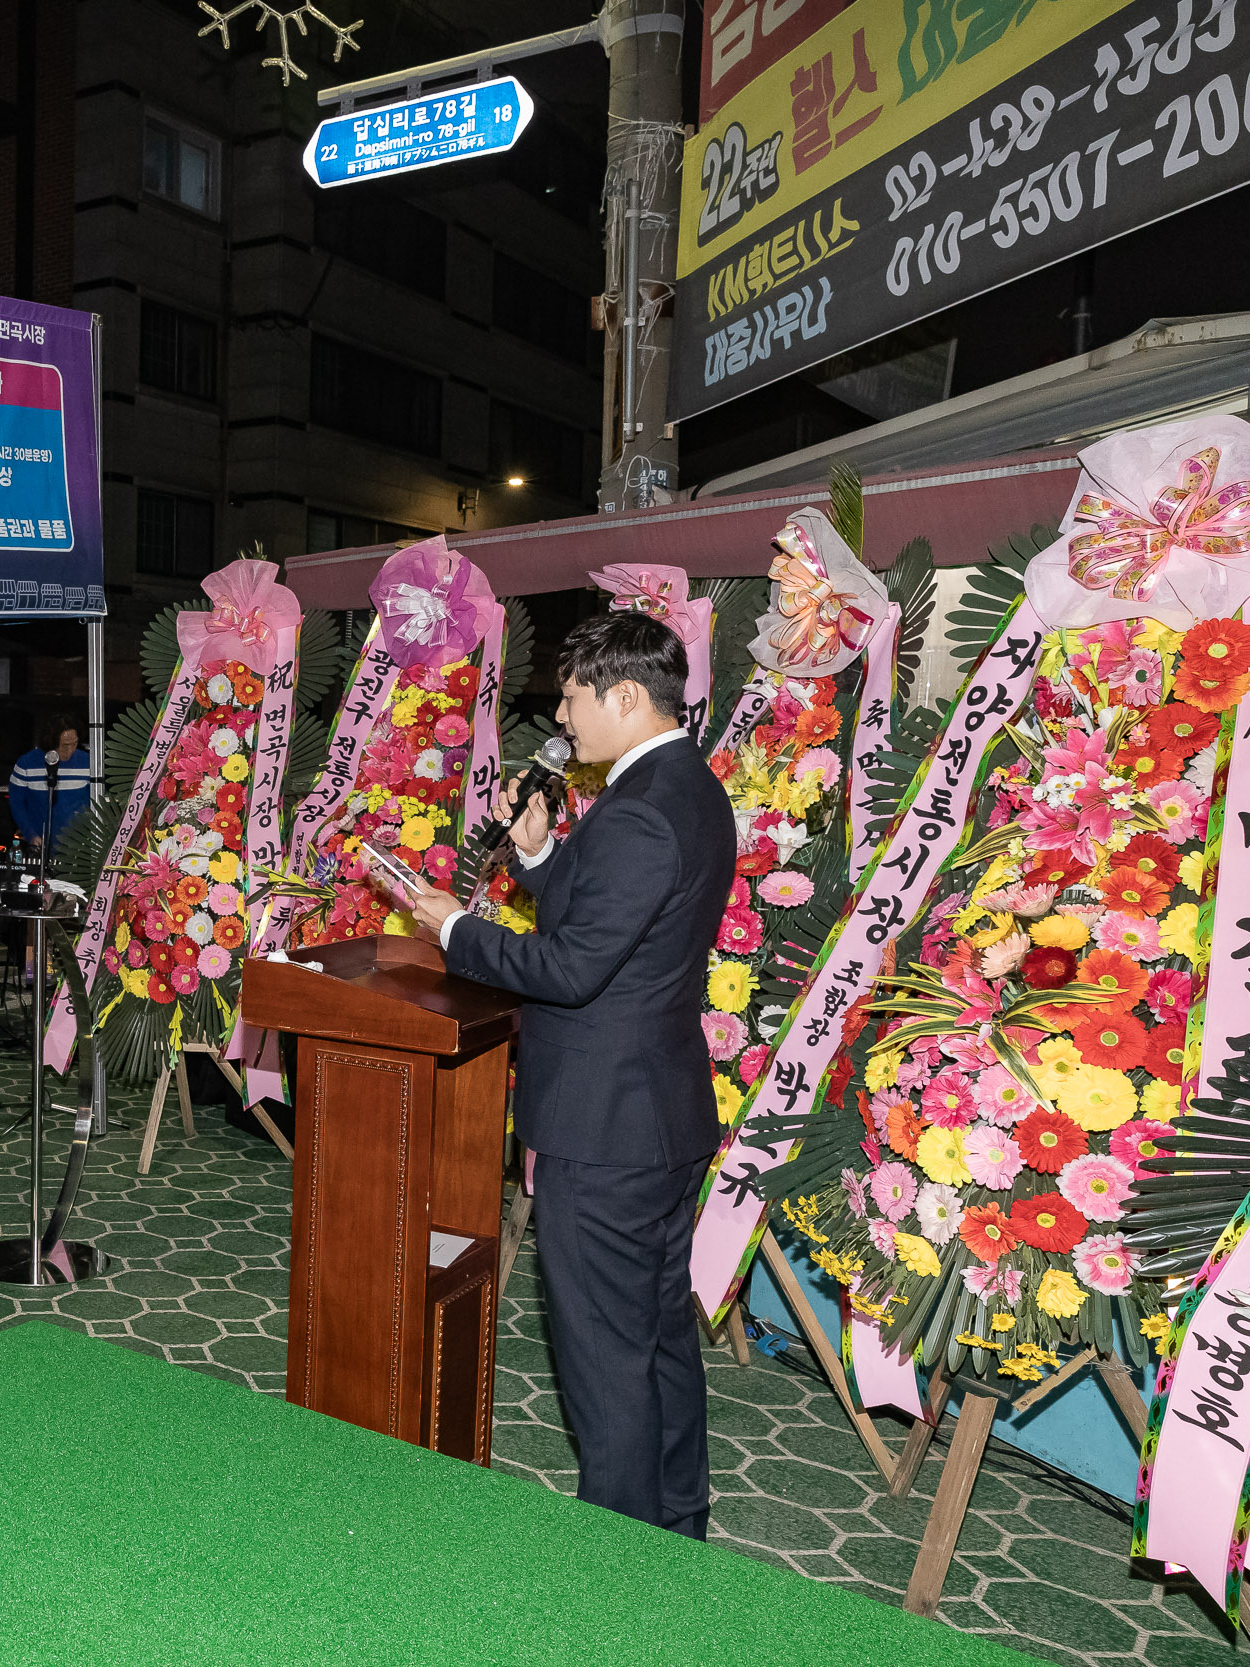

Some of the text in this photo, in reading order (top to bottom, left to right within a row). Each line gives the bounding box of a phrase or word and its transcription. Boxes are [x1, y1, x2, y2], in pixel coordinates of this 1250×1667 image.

[355, 118, 476, 158] Dapsimni-ro 78-gil
[494, 104, 513, 124] 18
[320, 144, 338, 162] 22
[699, 125, 782, 237] 22주년
[886, 70, 1250, 297] 010-5507-20
[707, 197, 860, 323] KM휘트니스
[0, 319, 46, 345] 면곡시장
[704, 276, 834, 387] 대중사우나
[37, 519, 67, 539] 물품
[266, 660, 295, 694] 祝
[345, 648, 399, 727] 광진구
[479, 661, 498, 718] 축
[861, 699, 889, 731] 축
[250, 704, 287, 829] 면곡시장
[297, 735, 361, 824] 전통시장
[803, 960, 864, 1047] 조합장
